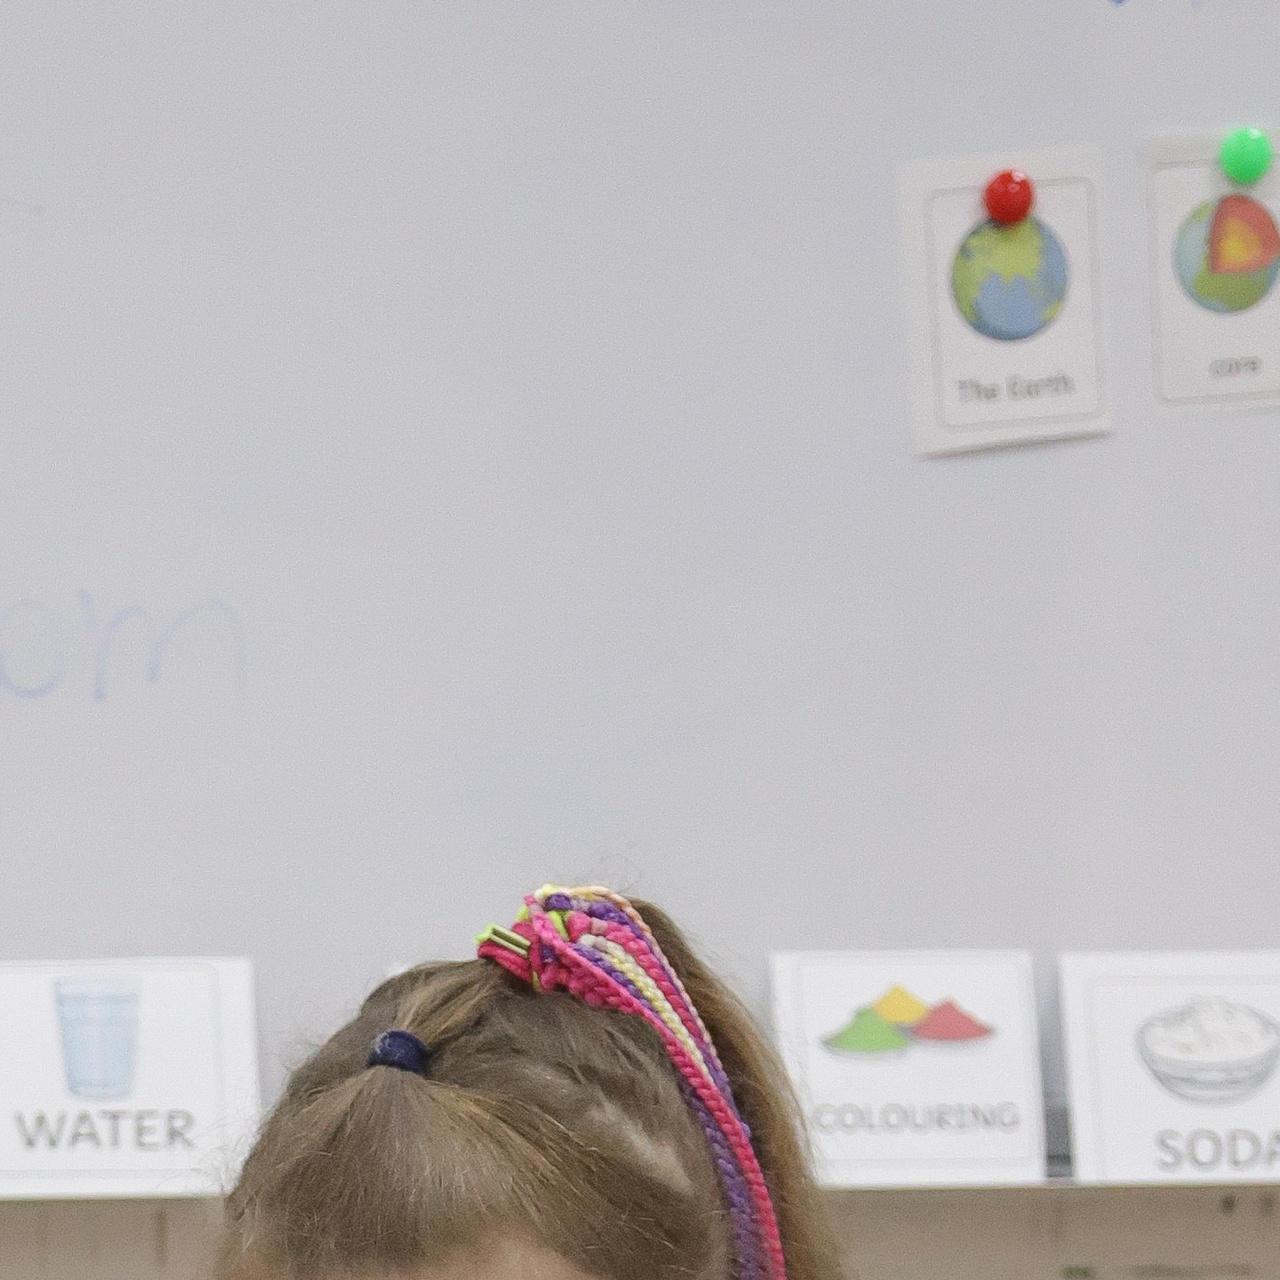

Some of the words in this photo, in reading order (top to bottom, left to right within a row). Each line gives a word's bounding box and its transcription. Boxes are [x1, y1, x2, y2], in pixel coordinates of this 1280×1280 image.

[1006, 369, 1076, 400] Earth
[14, 1108, 196, 1149] WATER
[811, 1101, 1021, 1135] COLOURING
